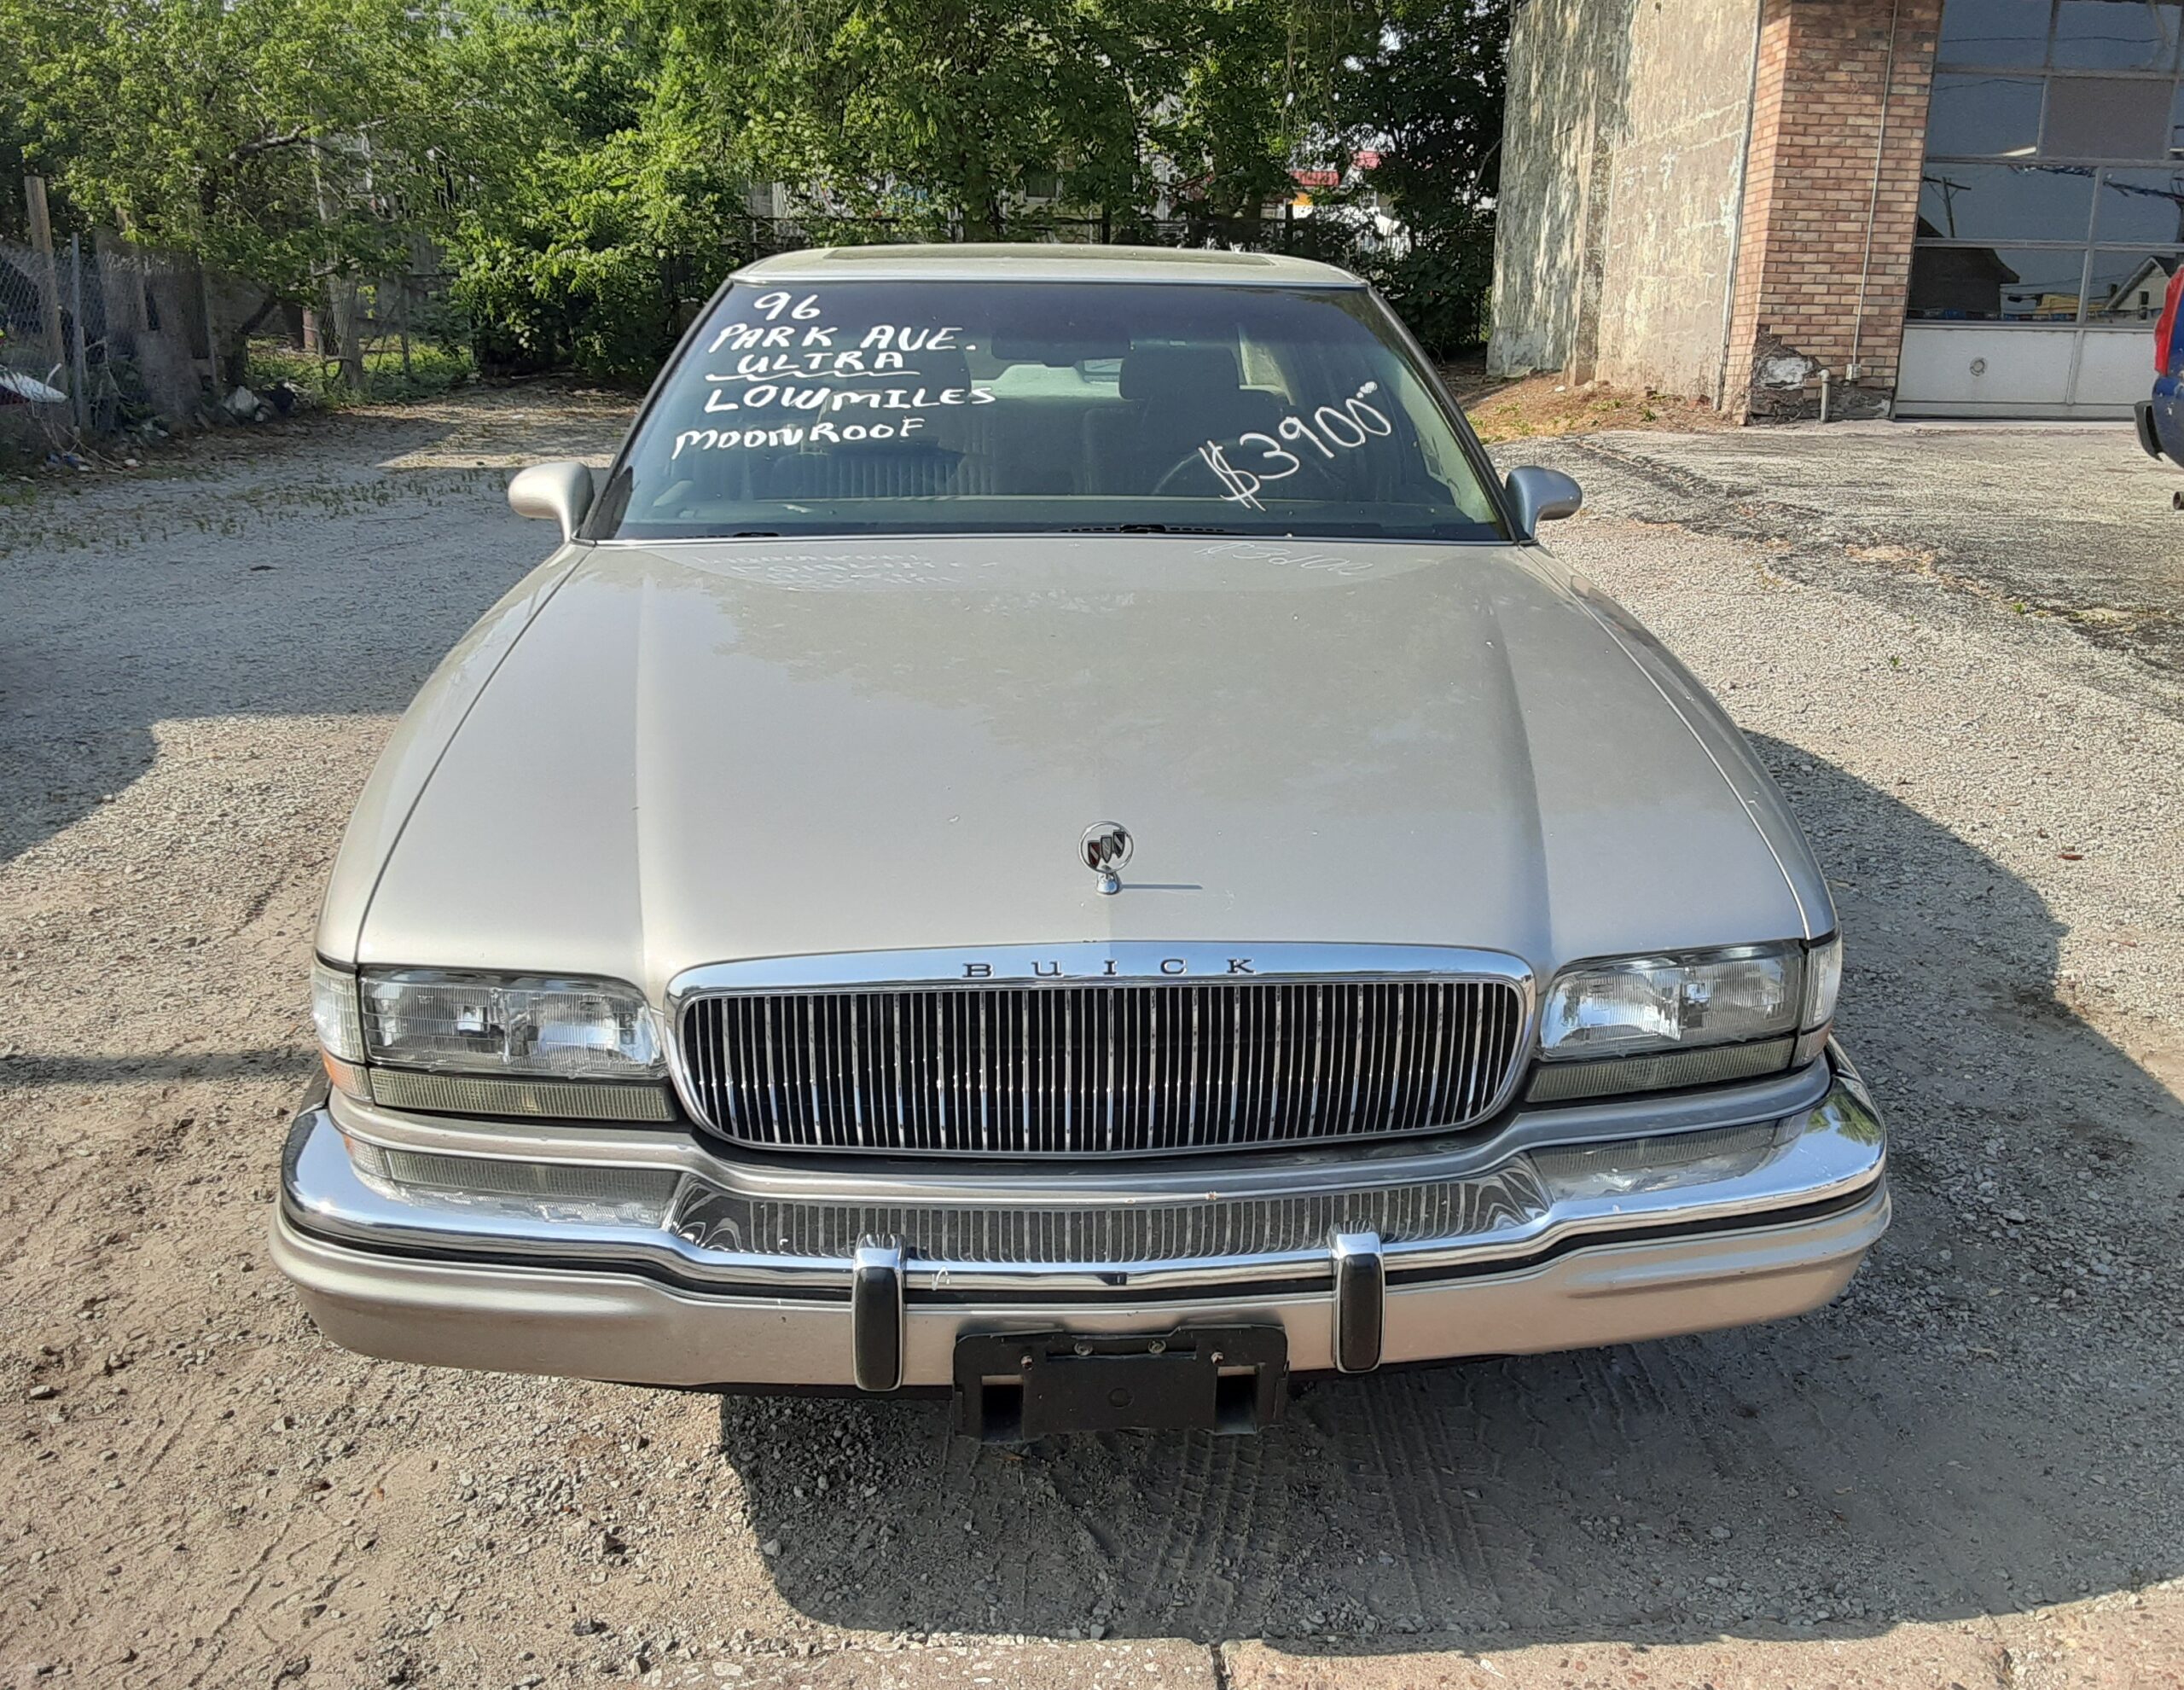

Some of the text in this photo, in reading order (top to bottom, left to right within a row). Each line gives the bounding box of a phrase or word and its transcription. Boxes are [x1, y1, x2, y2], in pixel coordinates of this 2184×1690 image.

[754, 292, 821, 321] 96
[708, 323, 839, 354] PARK
[737, 351, 904, 373] ULTRA
[962, 958, 1257, 978] BUICK
